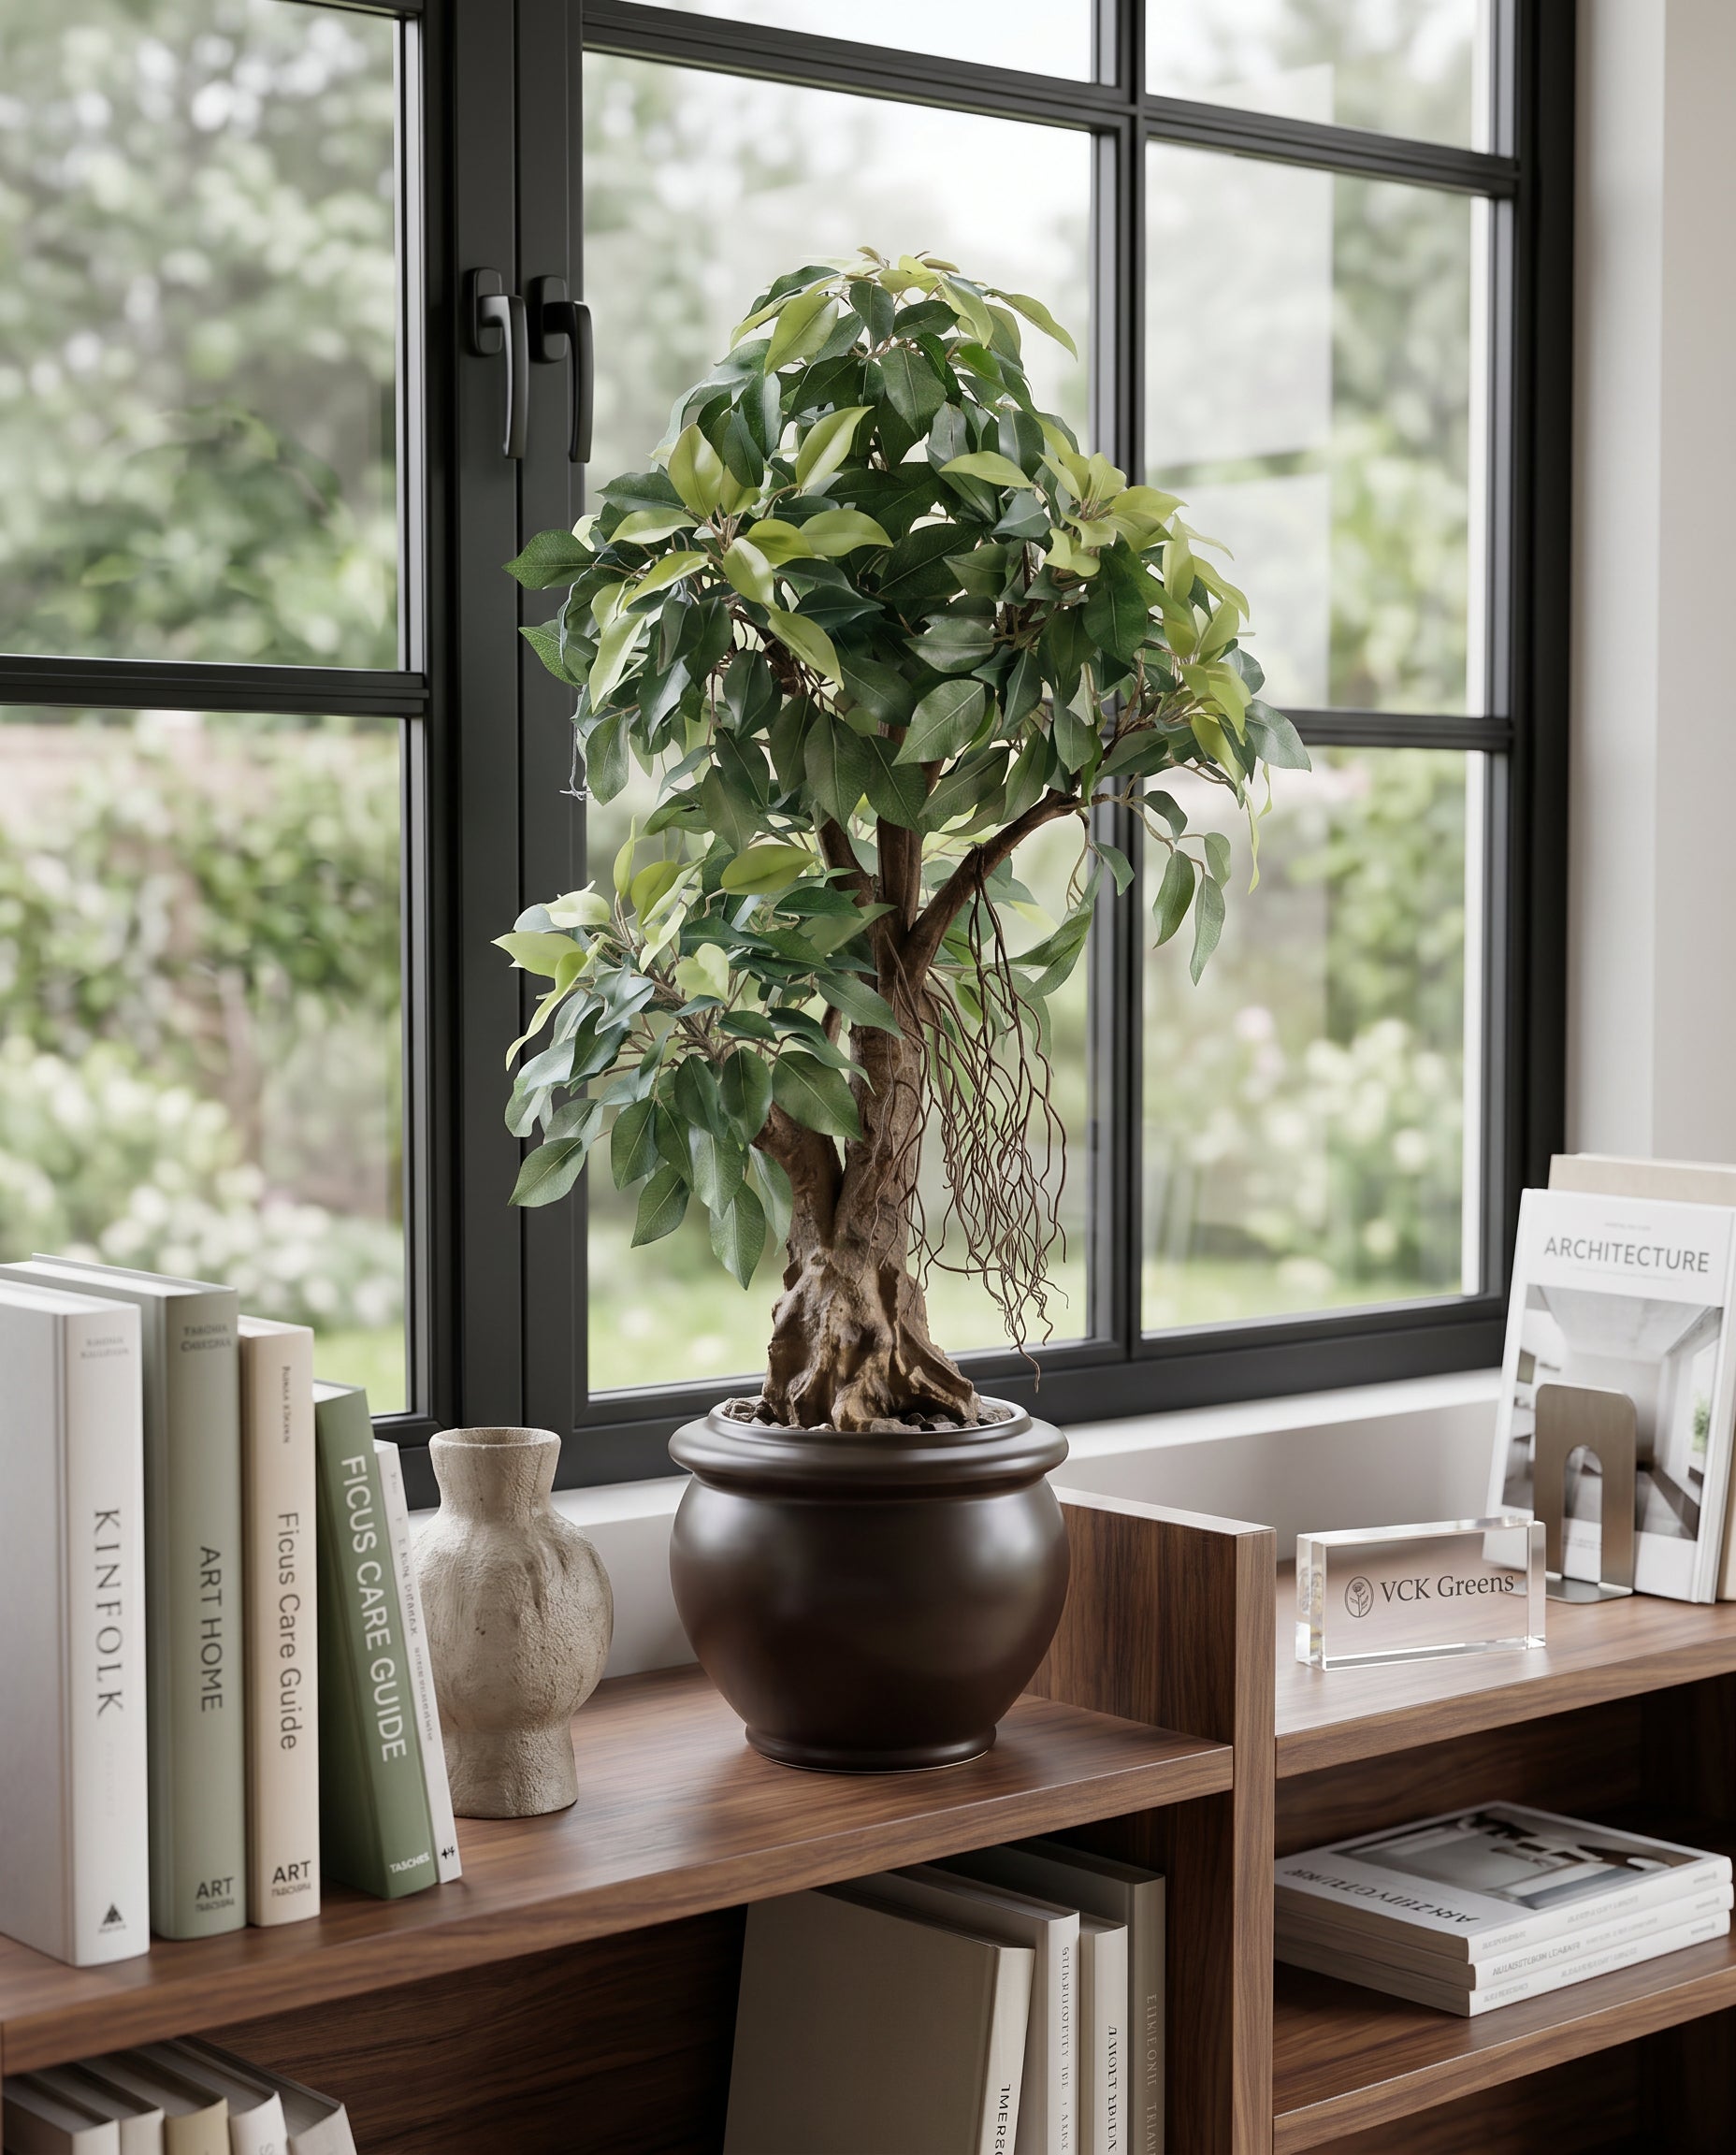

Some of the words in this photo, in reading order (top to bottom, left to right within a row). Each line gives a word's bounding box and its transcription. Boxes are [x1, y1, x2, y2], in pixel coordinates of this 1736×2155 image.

[1544, 1236, 1710, 1273] ARCHITECTURE
[340, 1454, 378, 1555] FICUS
[199, 1545, 223, 1608] ART
[277, 1511, 300, 1585] Ficus
[94, 1508, 123, 1718] KINFOLK
[356, 1560, 392, 1652] CARE
[1380, 1577, 1432, 1604] VCK
[1437, 1572, 1515, 1598] Greens
[279, 1593, 301, 1659] Care
[200, 1616, 224, 1713] HOME
[280, 1667, 303, 1750] Guide
[370, 1656, 408, 1762] GUIDE
[195, 1876, 235, 1901] ART
[272, 1860, 311, 1885] ART
